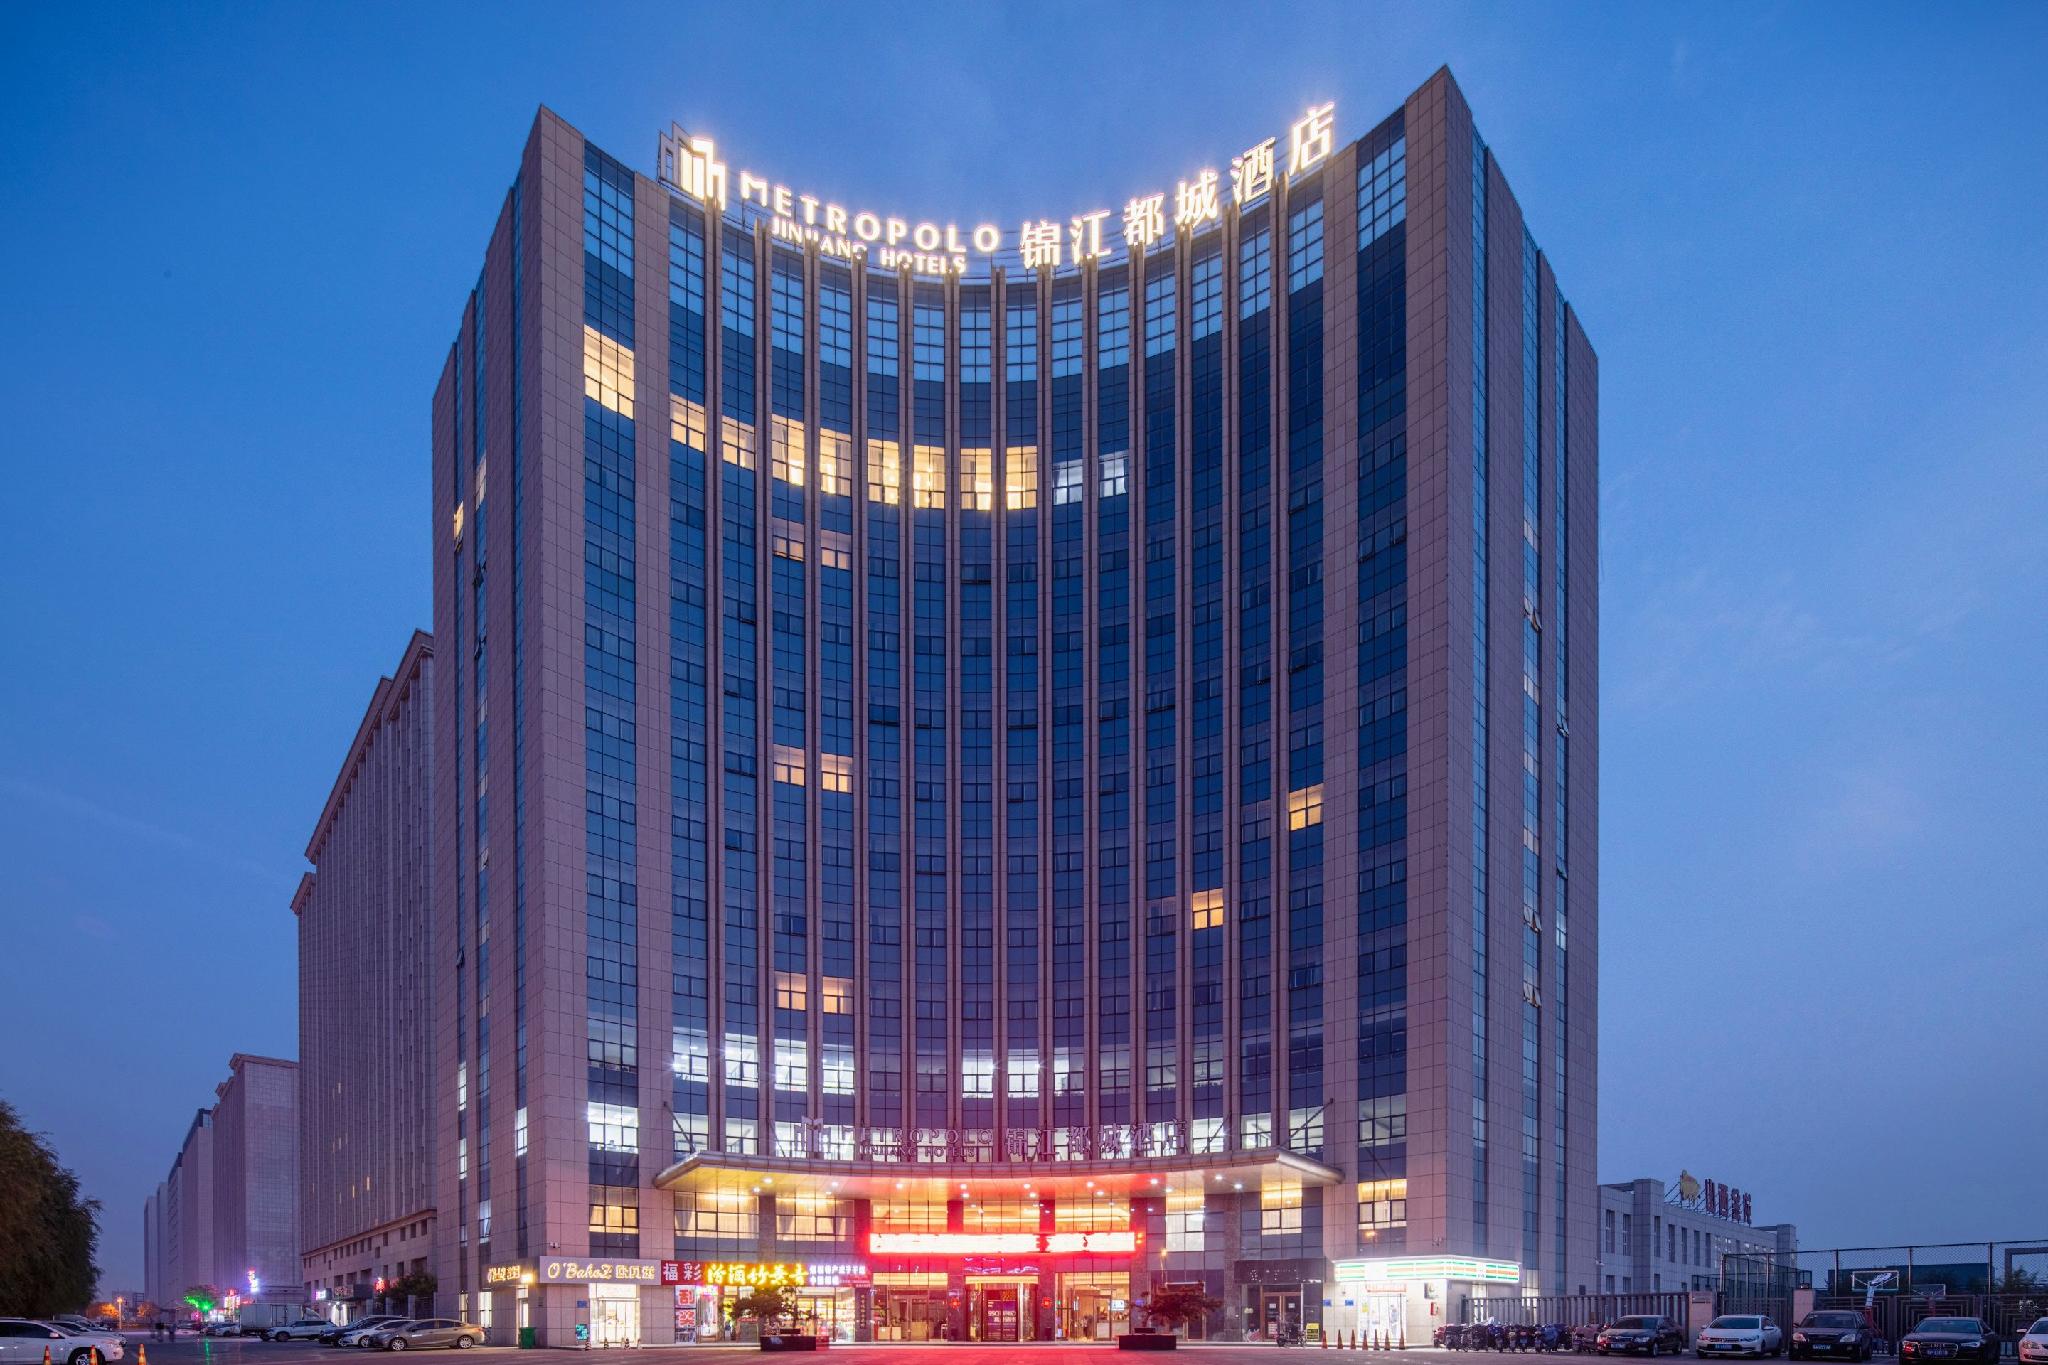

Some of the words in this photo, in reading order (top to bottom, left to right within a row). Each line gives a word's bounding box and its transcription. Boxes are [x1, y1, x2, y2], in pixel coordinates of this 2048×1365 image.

[1019, 101, 1335, 269] 锦江都城酒店
[740, 170, 999, 252] METROPOLO
[879, 247, 966, 275] HOTELS
[840, 1125, 993, 1145] METROPOLO
[1004, 1118, 1187, 1157] 锦江都城酒店
[663, 1263, 702, 1281] 福彩
